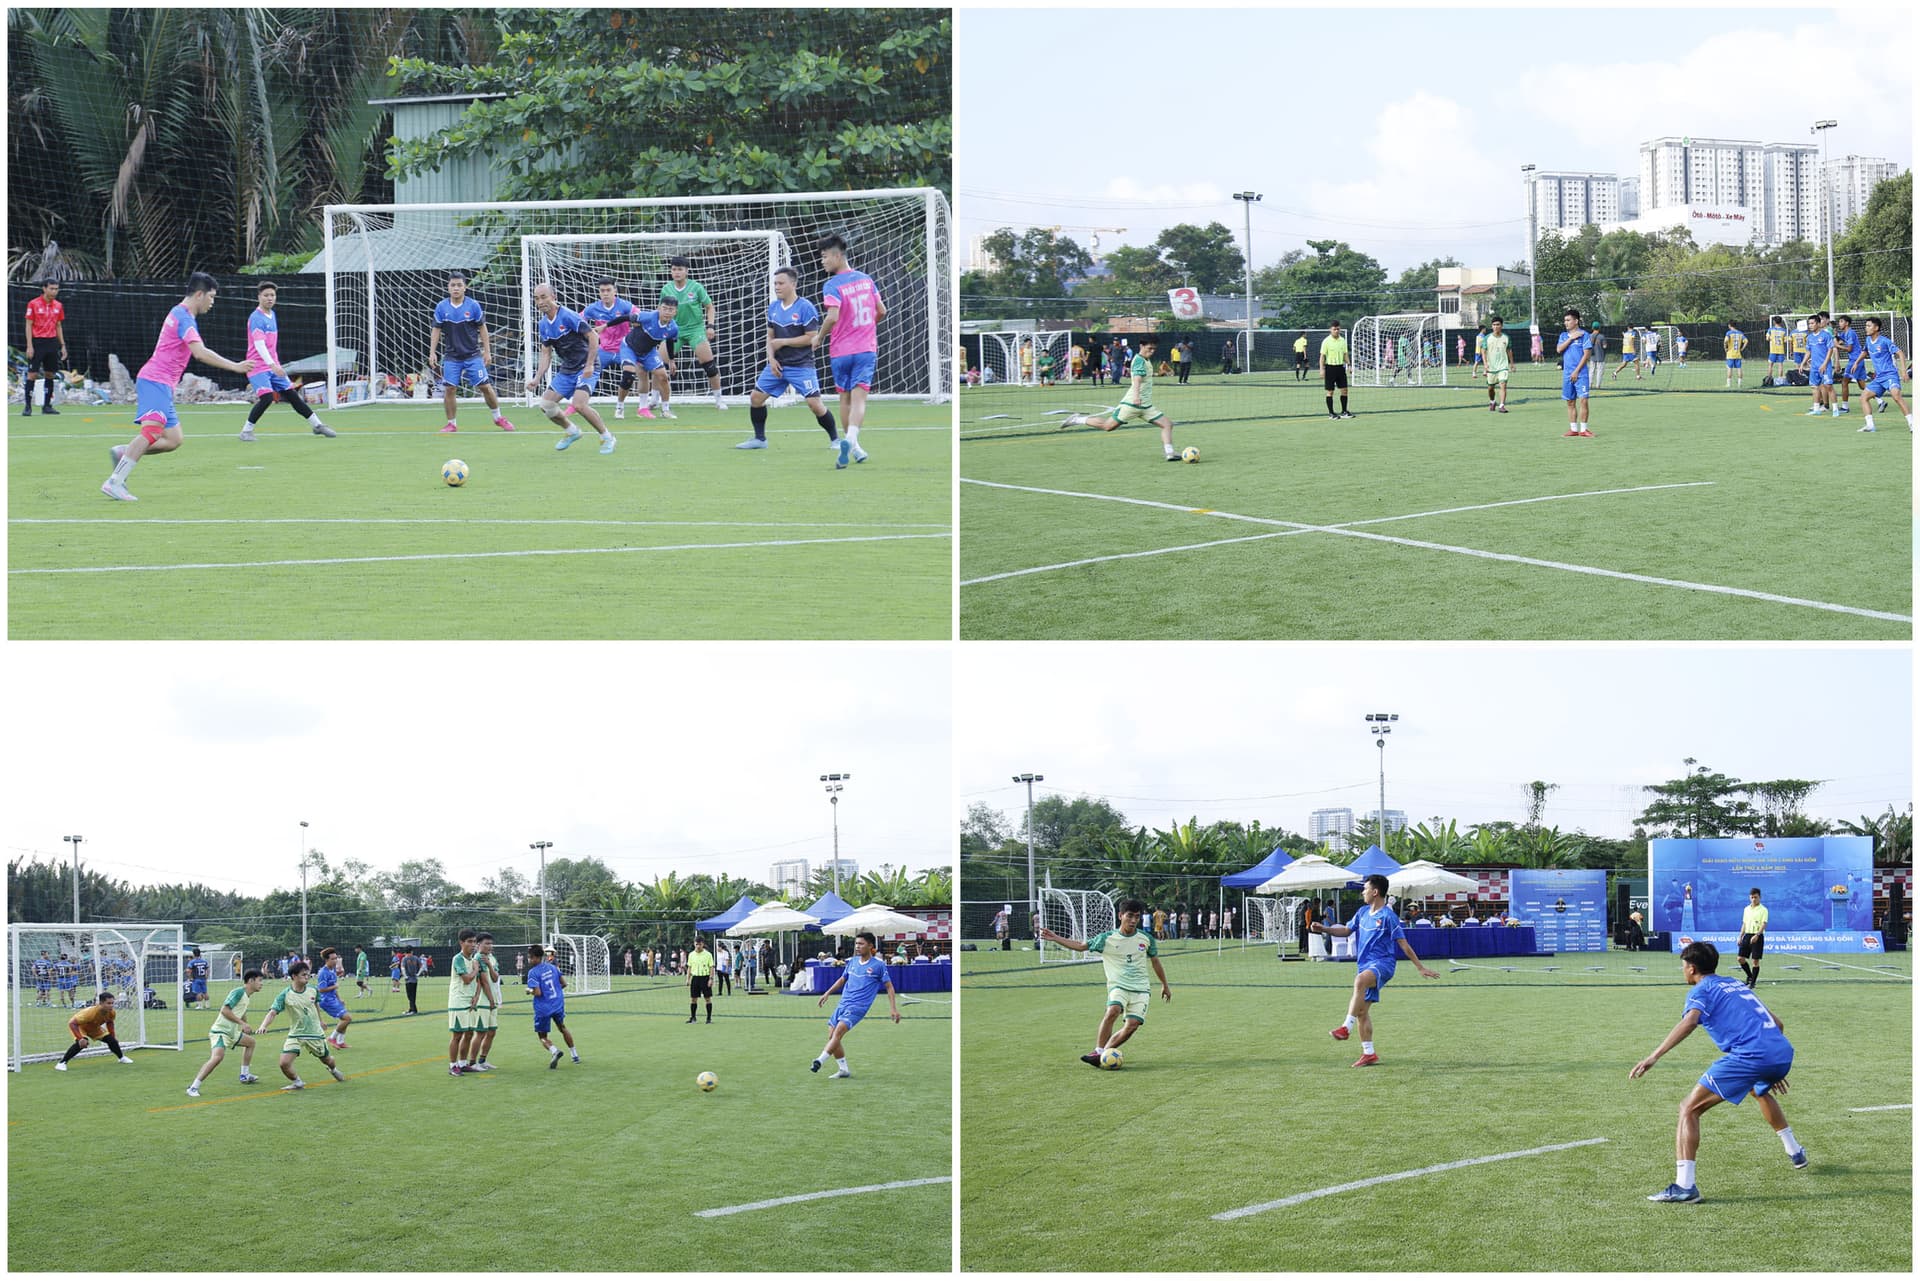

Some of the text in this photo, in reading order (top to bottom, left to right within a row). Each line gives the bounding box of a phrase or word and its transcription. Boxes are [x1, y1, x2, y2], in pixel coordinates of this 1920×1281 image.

[850, 293, 874, 329] 16
[1175, 288, 1200, 316] 3
[196, 965, 206, 976] 15
[1127, 954, 1133, 963] 3
[544, 979, 557, 999] 3
[1739, 993, 1777, 1029] 3
